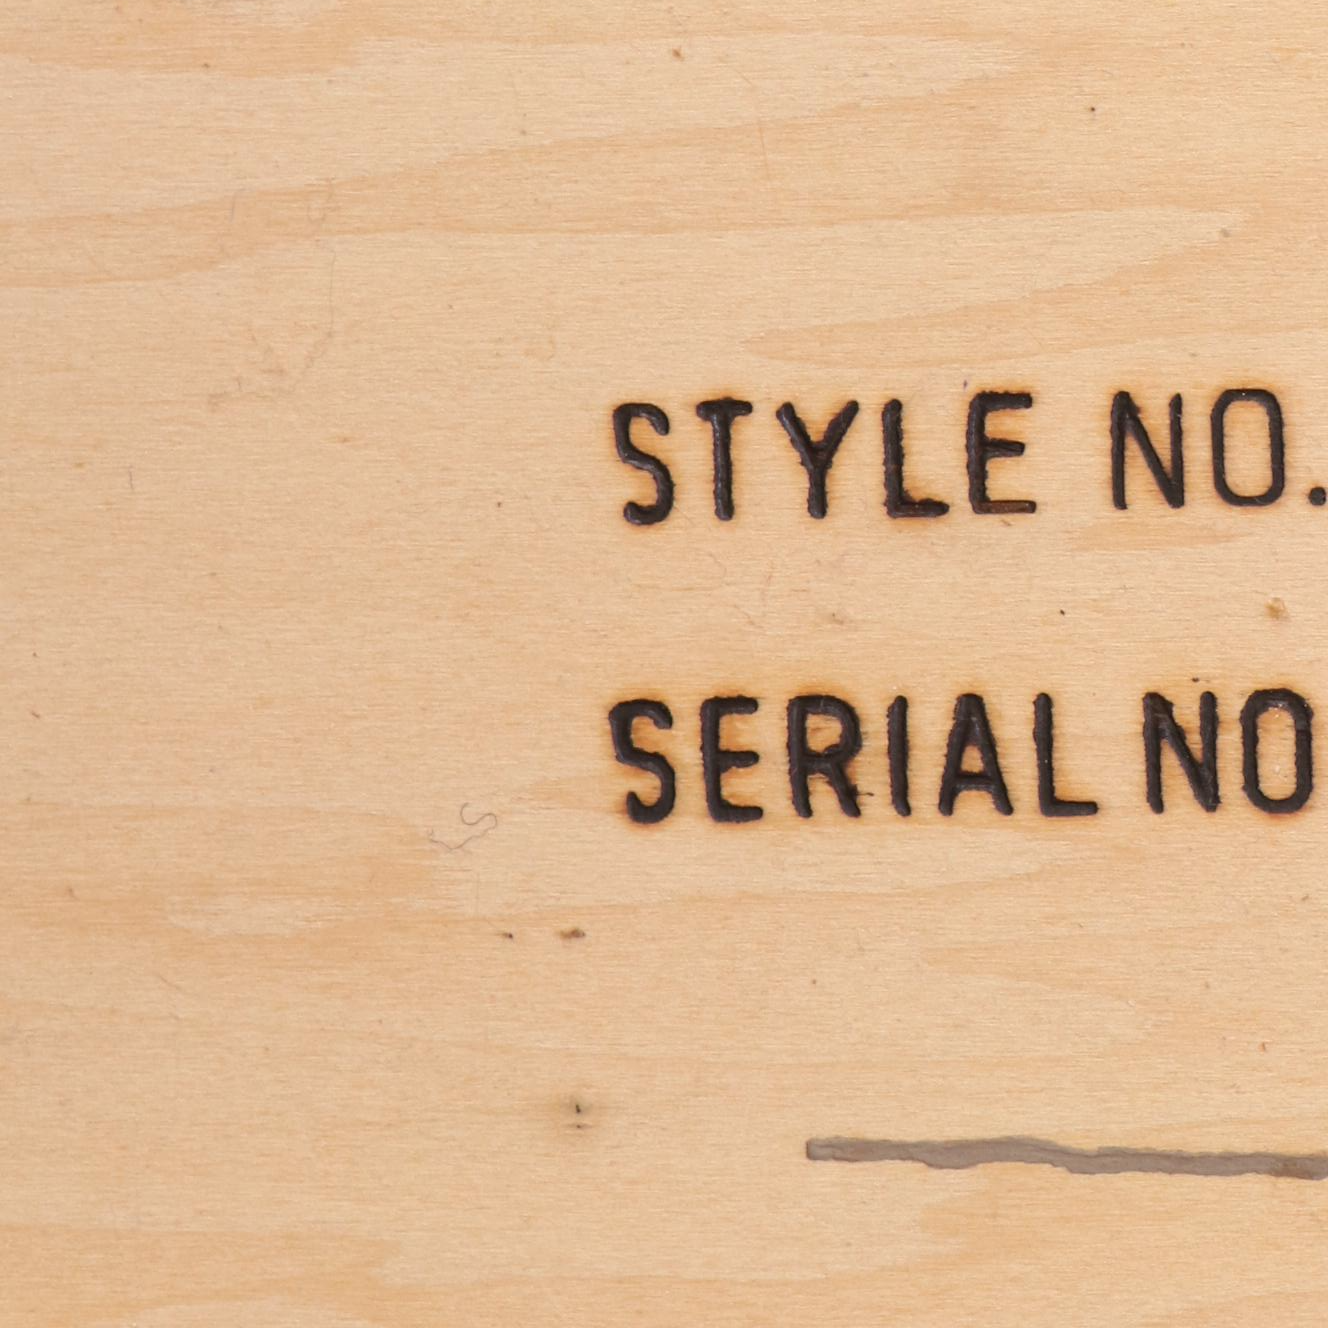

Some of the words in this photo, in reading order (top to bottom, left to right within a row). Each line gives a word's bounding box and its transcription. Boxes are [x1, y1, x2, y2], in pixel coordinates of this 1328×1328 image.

[612, 389, 1037, 527] STYLE
[1109, 387, 1327, 511] NO.
[607, 692, 1100, 825] SERIAL
